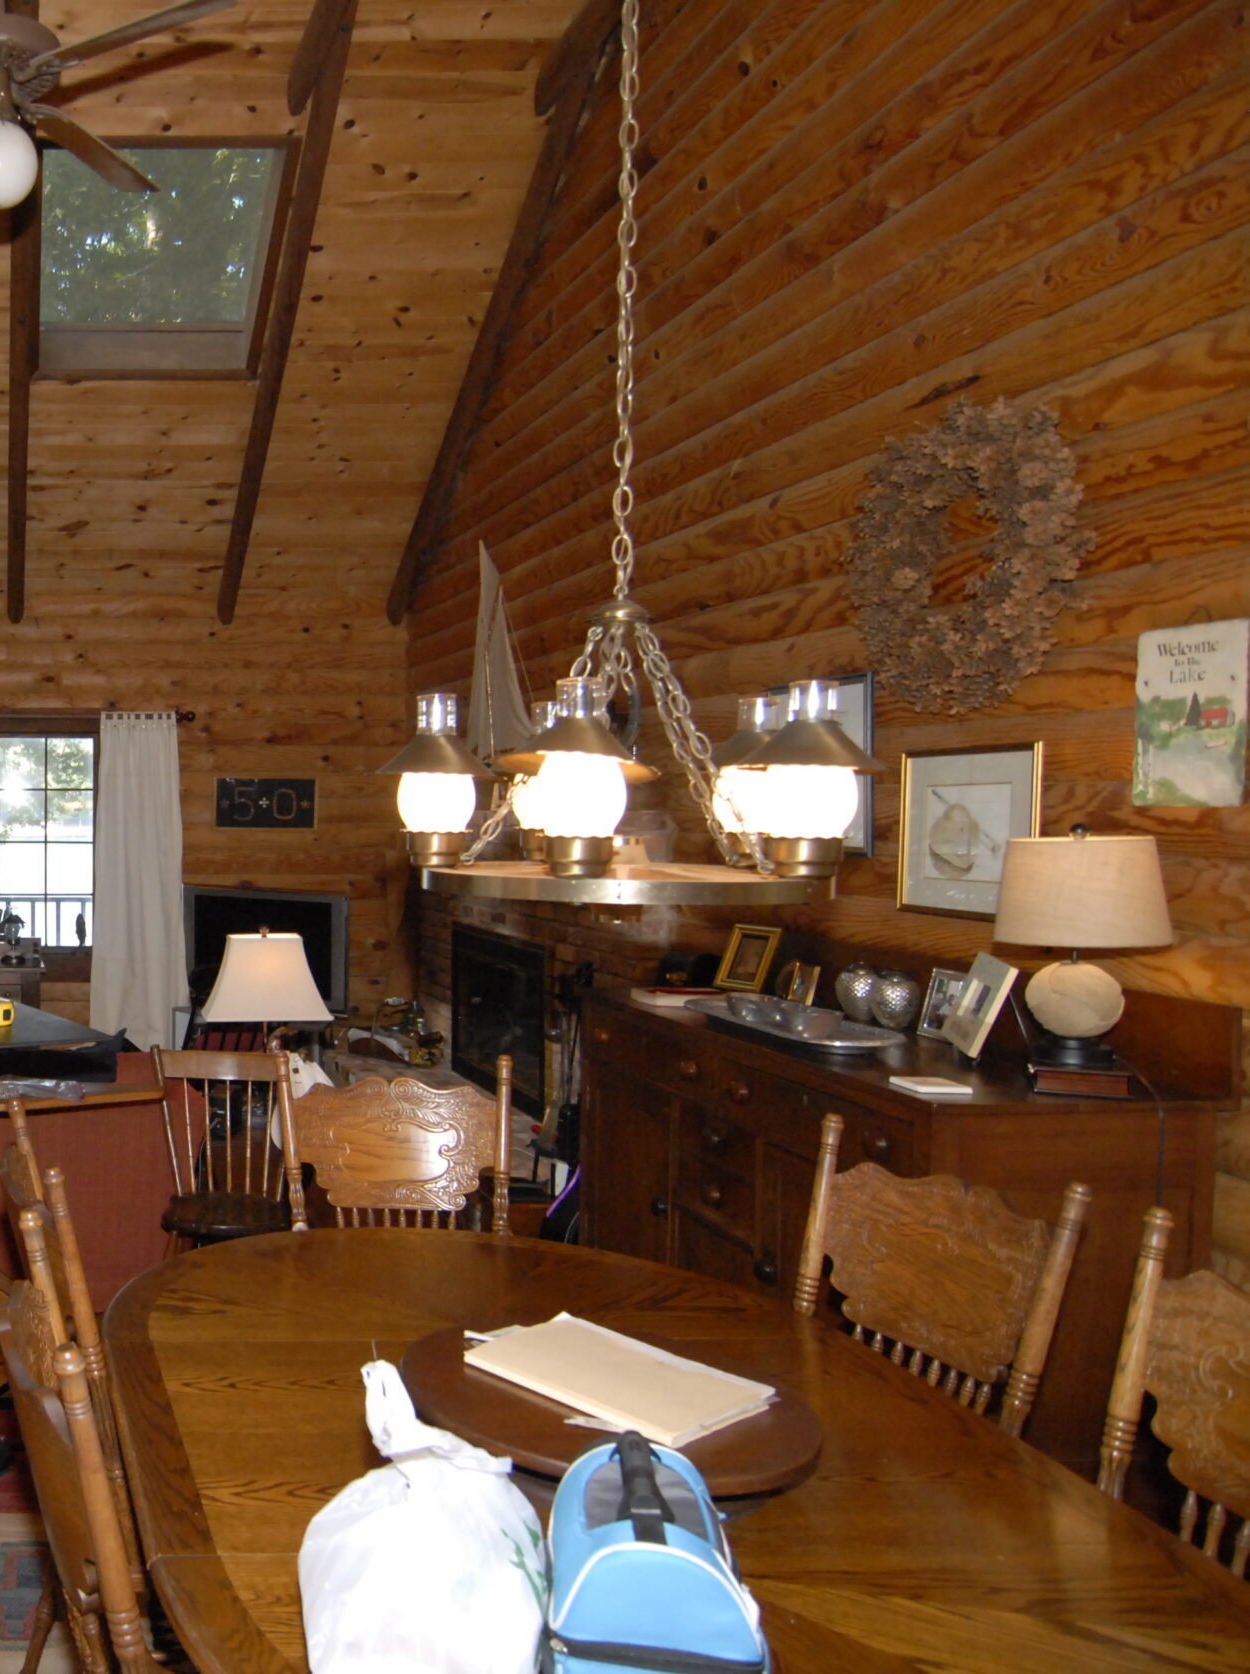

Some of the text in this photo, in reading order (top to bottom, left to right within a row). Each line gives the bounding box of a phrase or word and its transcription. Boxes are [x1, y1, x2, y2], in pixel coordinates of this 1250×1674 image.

[1157, 640, 1220, 657] Welcome
[1174, 656, 1201, 667] to the
[1169, 668, 1206, 684] Lake
